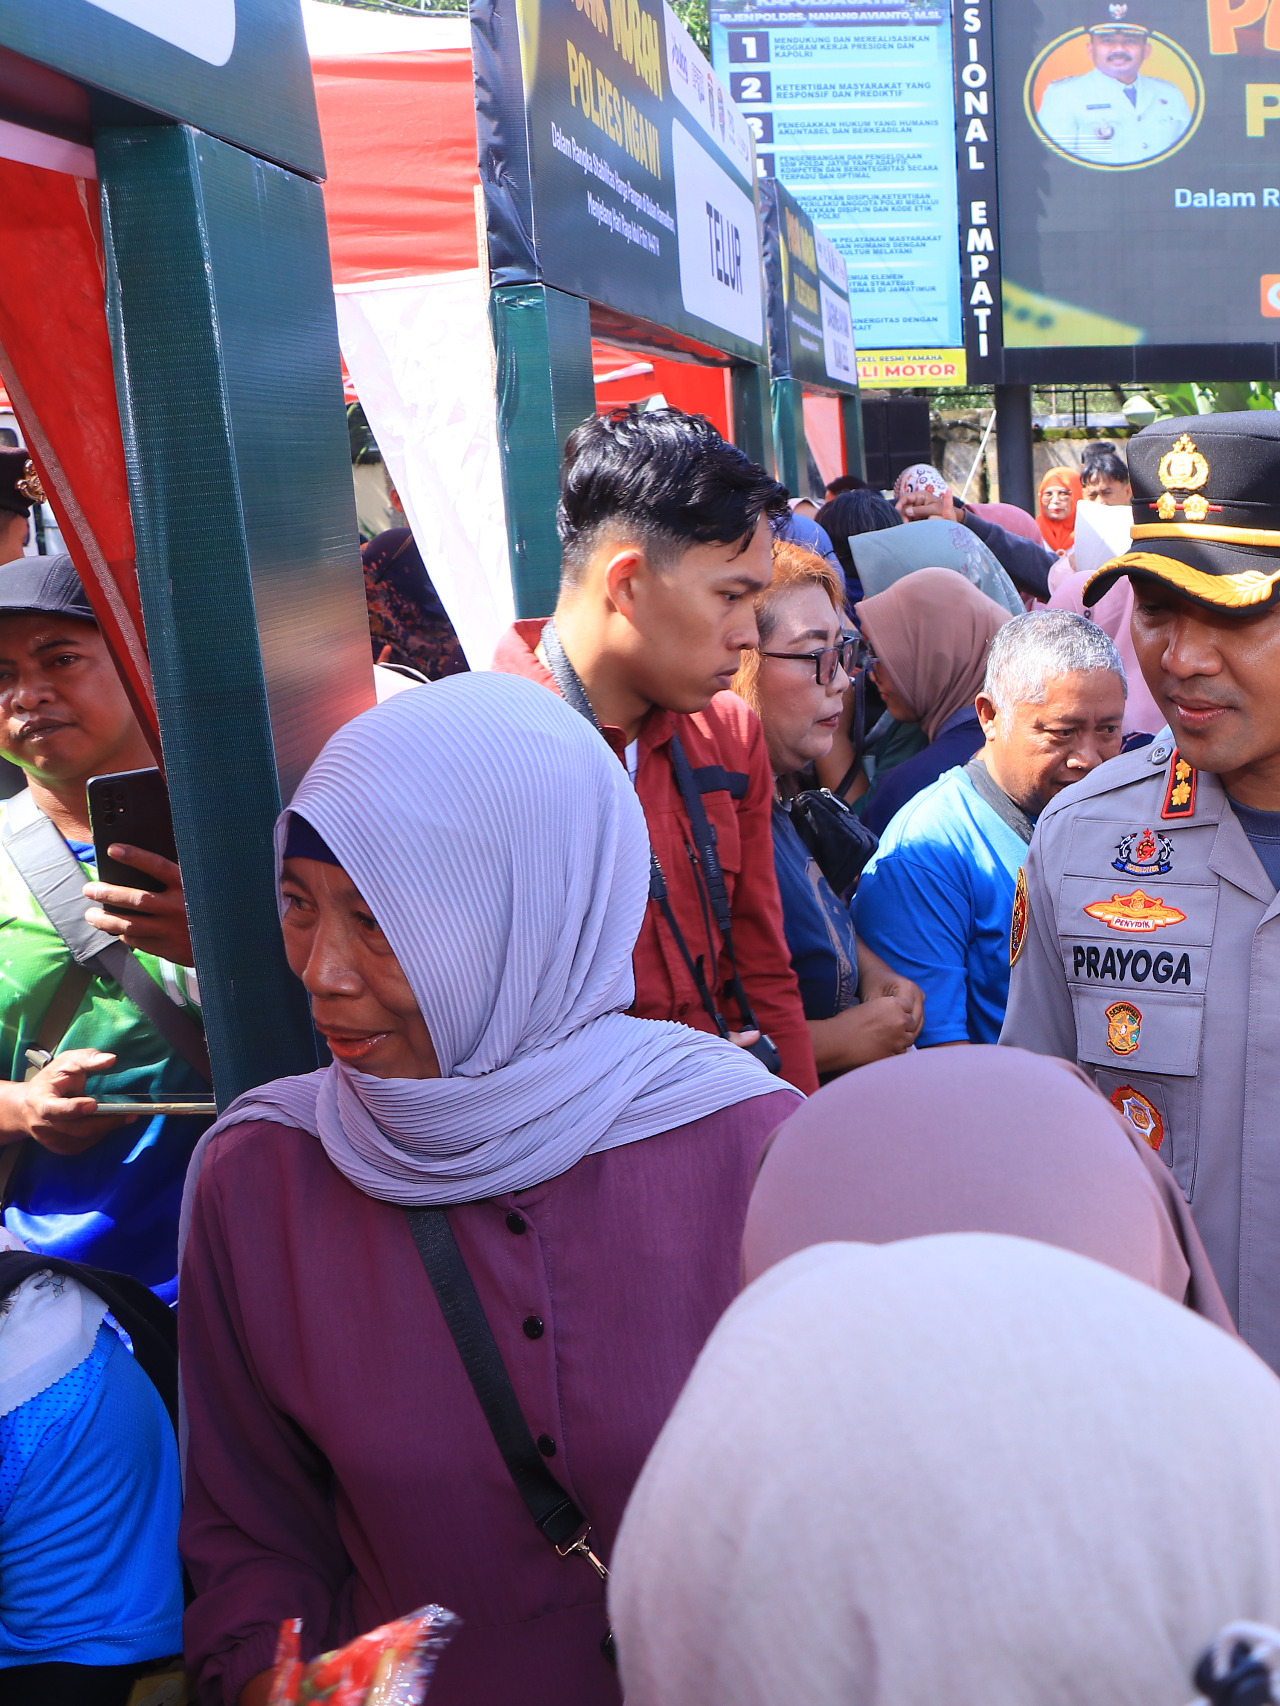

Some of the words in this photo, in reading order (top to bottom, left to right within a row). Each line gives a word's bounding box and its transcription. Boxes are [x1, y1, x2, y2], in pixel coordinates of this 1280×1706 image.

[808, 12, 858, 20] NANANG
[742, 36, 758, 59] 1
[774, 36, 831, 44] MENDUKUNG
[853, 35, 930, 43] MEREALISASIKAN
[775, 43, 818, 51] PROGRAM
[741, 77, 762, 99] 2
[776, 84, 836, 92] KETERTIBAN
[838, 82, 903, 90] MASYARAKAT
[776, 91, 829, 99] RESPONSIF
[832, 90, 851, 98] DAN
[854, 89, 904, 97] PREDIKTIF
[962, 0, 989, 171] SIONAL
[566, 39, 622, 148] POLRES
[622, 95, 662, 181] NGAWI
[777, 121, 837, 129] PENEGAKKAN
[899, 119, 939, 127] HUMANIS
[551, 120, 572, 160] Dalam
[571, 136, 593, 175] Rangka
[1174, 188, 1256, 209] Dalam
[705, 200, 743, 295] TELUR
[966, 200, 995, 357] EMPATI
[885, 364, 956, 377] MOTOR
[1114, 917, 1151, 929] PENYIDIK
[1073, 945, 1192, 986] PRAYOGA
